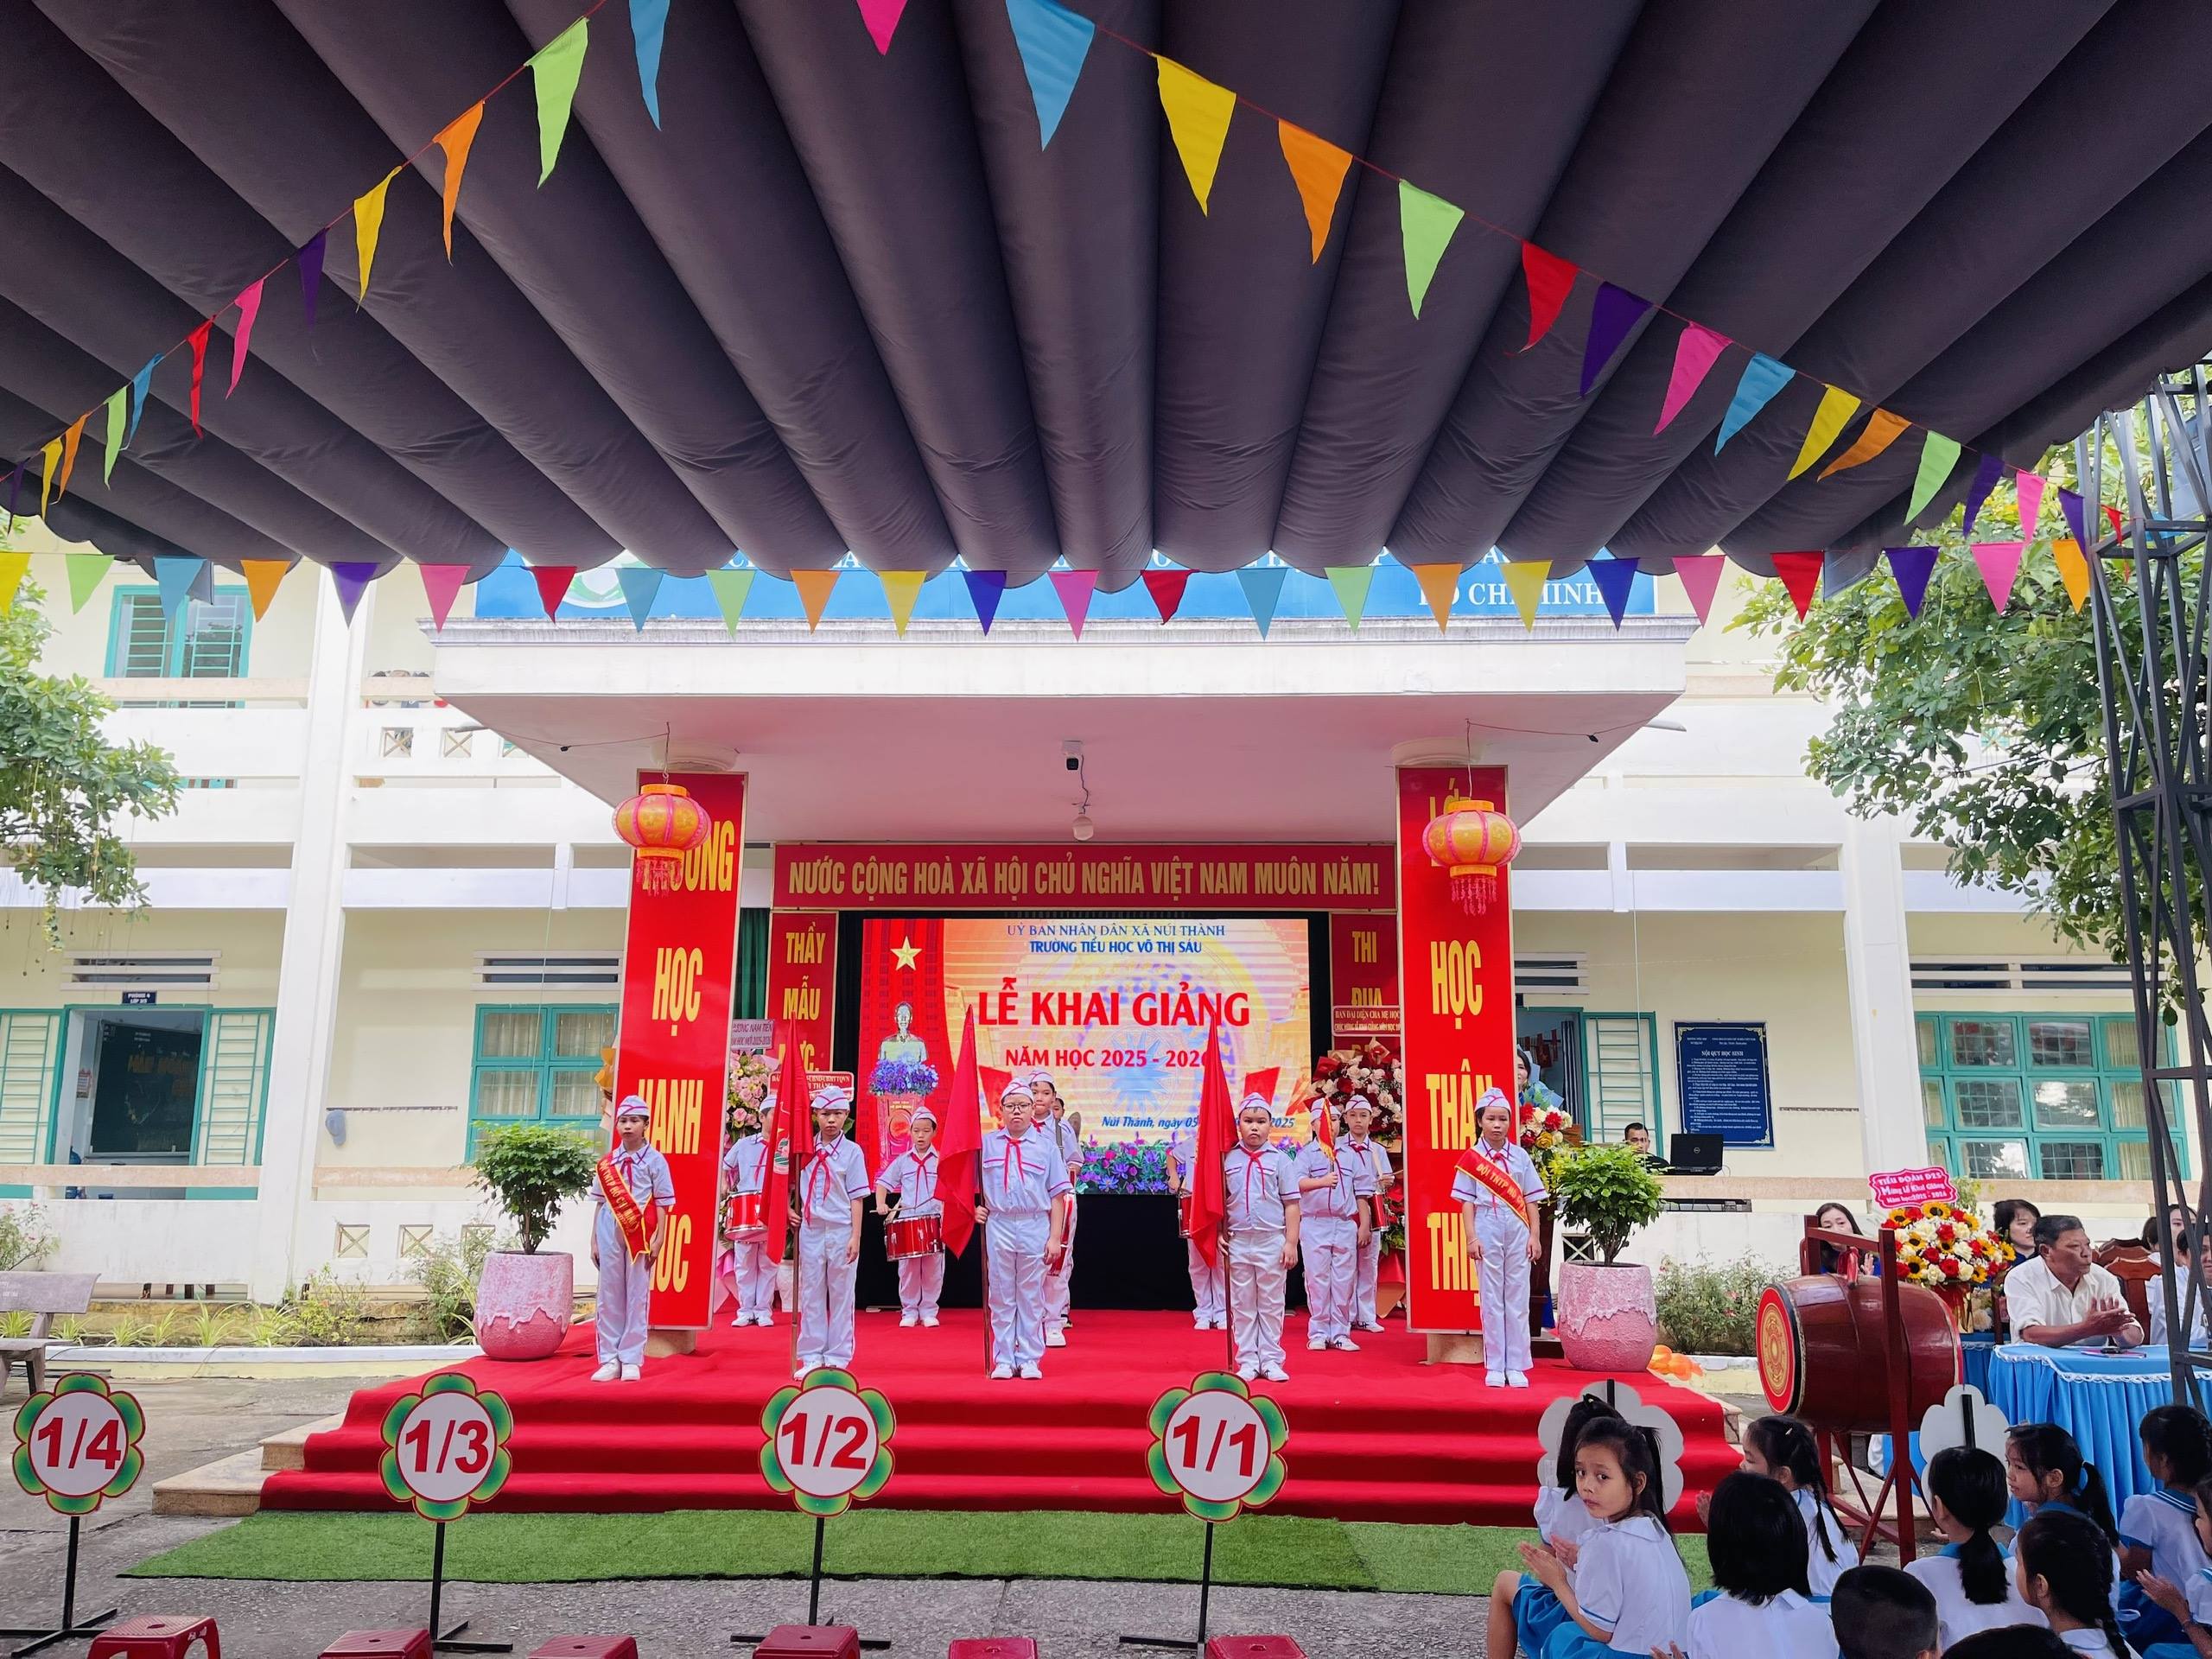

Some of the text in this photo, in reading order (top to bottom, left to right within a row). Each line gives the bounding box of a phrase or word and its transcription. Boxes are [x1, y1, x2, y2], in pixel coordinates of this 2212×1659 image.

[788, 851, 1379, 901] NƯỚC CỘNG HOÀ XÃ HỘI CHỦ NGHĨA VIỆT NAM MUÔN NĂM!
[785, 921, 826, 964] THẦY
[1029, 925, 1056, 936] BAN
[1059, 922, 1096, 936] NHÂN
[1100, 922, 1128, 936] DÂN
[1132, 922, 1150, 936] XÃ
[1154, 922, 1176, 936] NÚI
[1180, 923, 1225, 936] THÀNH
[1029, 937, 1202, 956] TRƯỜNG TIỂU HỌC VÕ THỊ SÁU
[1351, 931, 1377, 963] THI
[652, 947, 703, 1037] HỌC
[783, 976, 821, 1021] MẪU
[978, 976, 1249, 1027] LỄ KHAI GIẢNG
[1430, 940, 1484, 1030] HỌC
[1005, 1046, 1049, 1067] NĂM
[1055, 1050, 1095, 1071] HỌC
[1101, 1050, 1147, 1067] 2025
[1102, 1116, 1120, 1127] Núi
[1158, 1117, 1182, 1129] ngày
[1490, 1172, 1510, 1189] TNTP
[36, 1416, 123, 1470] 1/4
[404, 1419, 489, 1474] 1/3
[780, 1412, 868, 1471] 1/2
[1172, 1414, 1257, 1478] 1/1
